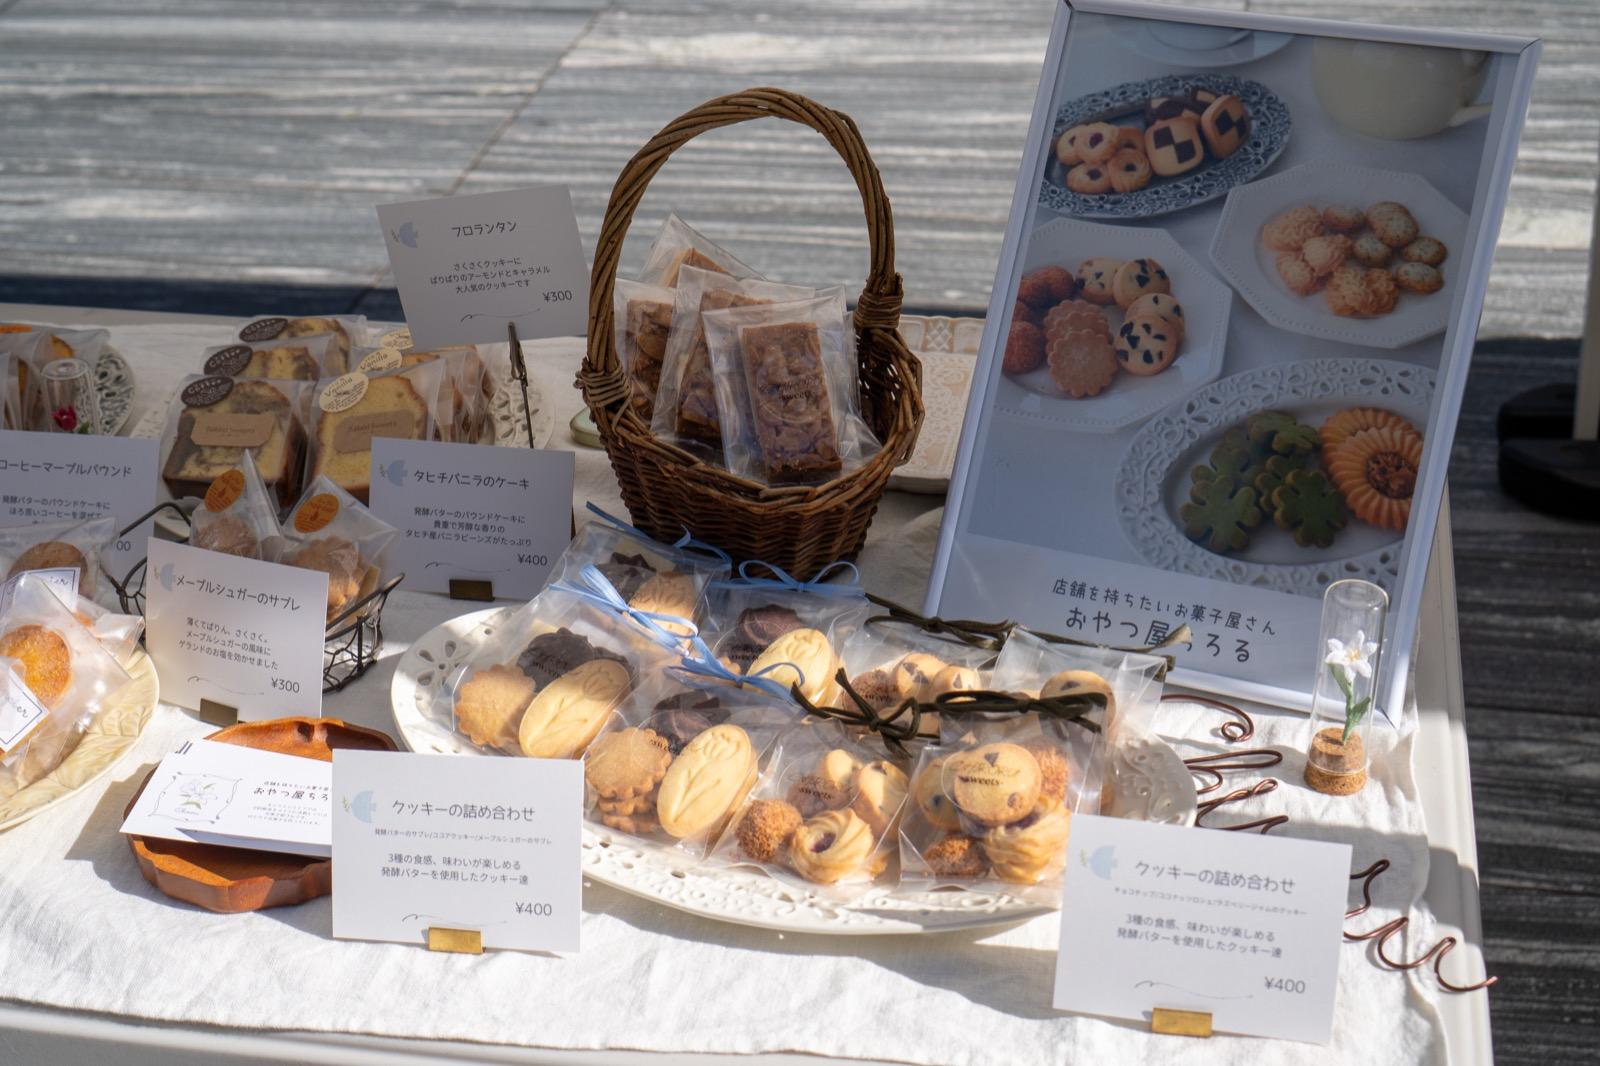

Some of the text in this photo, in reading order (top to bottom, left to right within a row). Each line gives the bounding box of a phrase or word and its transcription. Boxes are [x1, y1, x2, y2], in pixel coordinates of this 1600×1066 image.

[451, 221, 518, 238] フロランタン
[453, 257, 522, 271] さくさくクッキーに
[429, 266, 551, 285] ぱりぱりのアーモンドとキャラメル
[455, 279, 531, 294] 大人気のクッキーです
[542, 290, 573, 303] ¥300
[413, 470, 530, 491] タヒチバニラのケーキ
[413, 507, 526, 524] 発酵バターのパウンドケーキに
[517, 553, 548, 566] ¥400
[176, 575, 301, 612] メープルシュガーのサブレ
[1052, 577, 1276, 637] 店舗を持ちたいお菓子屋さん
[271, 676, 301, 694] ¥300
[392, 799, 536, 823] クッキーの詰め合わせ
[387, 852, 522, 871] 3種の食感、味わいが楽しめる
[381, 866, 529, 886] 発酵バターを使用したクッキー達
[1134, 860, 1296, 895] クッキーの詰め合わせ
[515, 901, 553, 917] ¥400
[1125, 913, 1276, 943] 3種の食感、味わいが楽しめる
[1116, 926, 1283, 959] 発酵バターを使用したクッキー達
[1264, 976, 1306, 995] ¥400
